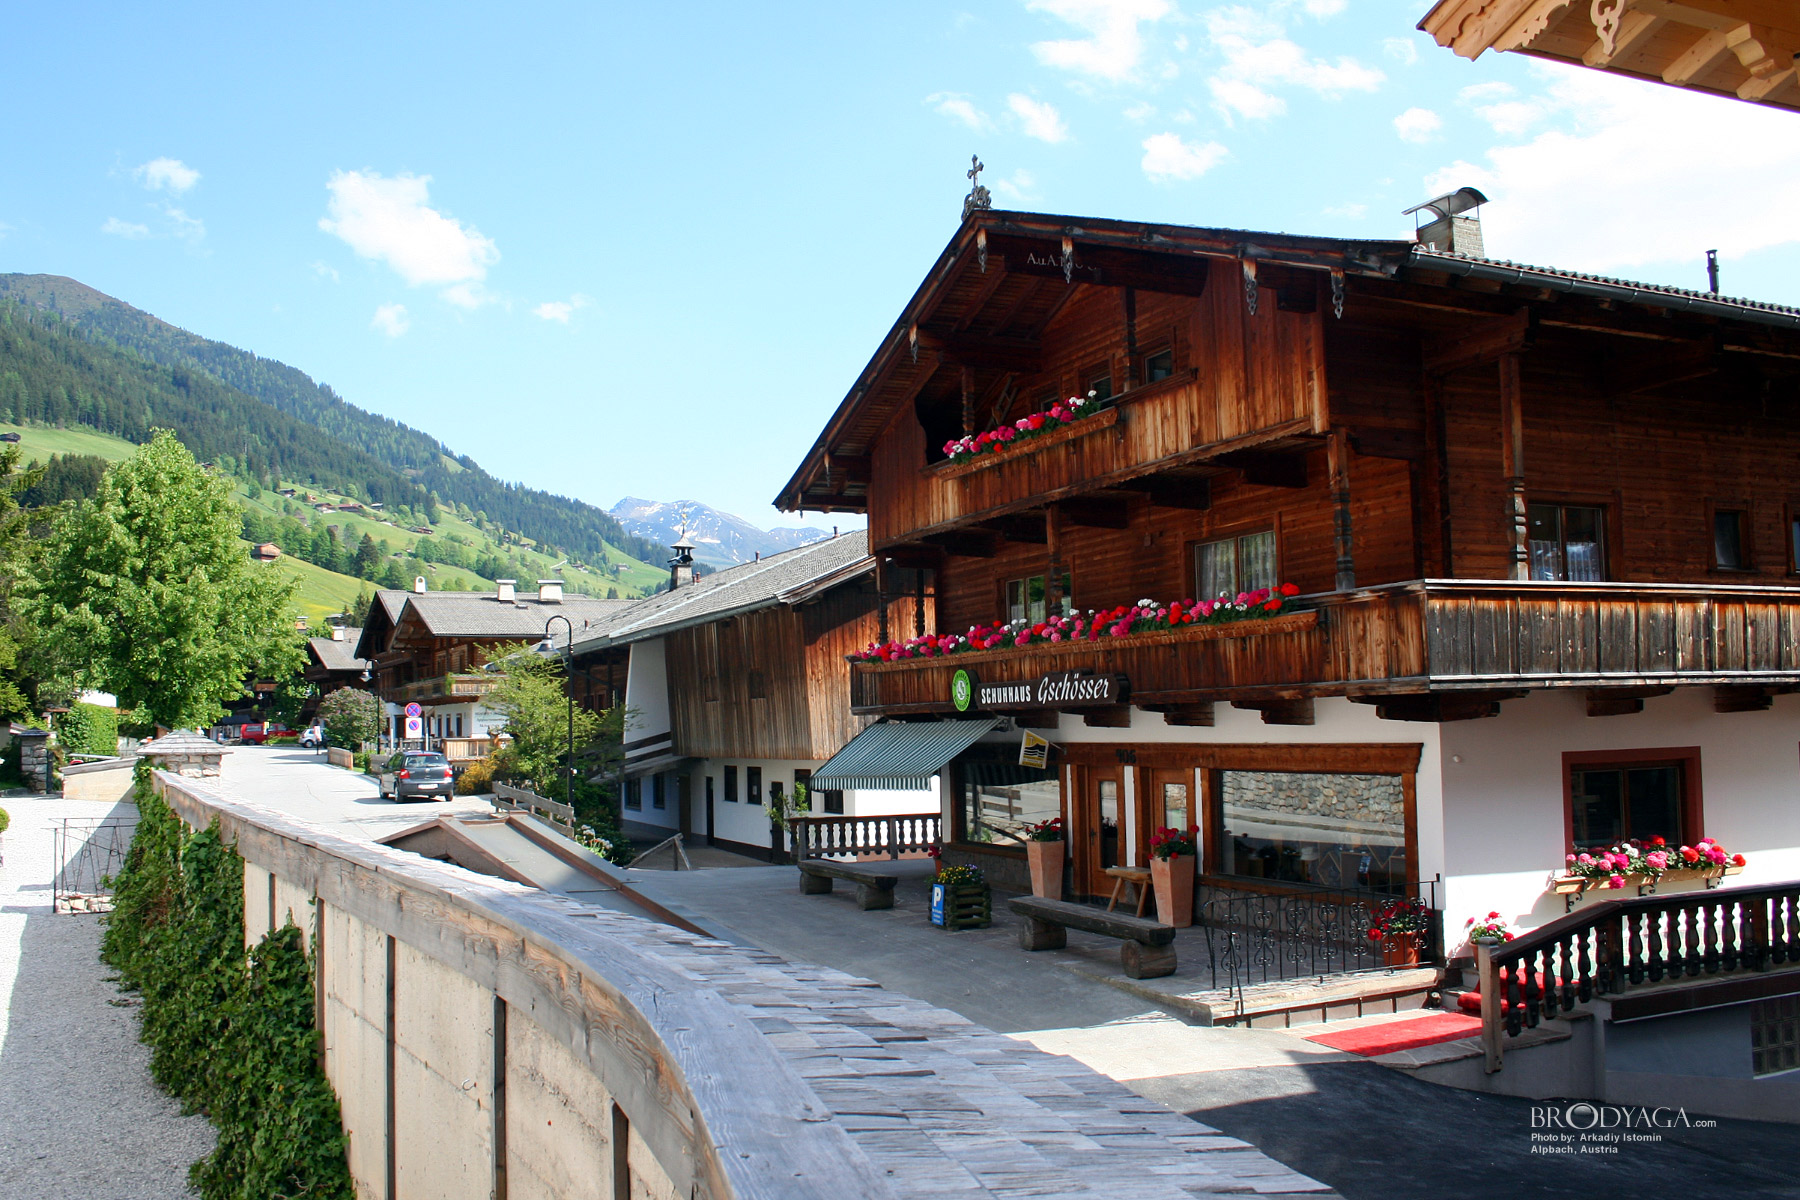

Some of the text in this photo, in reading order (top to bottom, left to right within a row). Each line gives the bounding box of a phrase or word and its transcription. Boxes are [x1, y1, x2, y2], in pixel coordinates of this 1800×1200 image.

[981, 685, 1031, 704] SCHUHHAUS
[1037, 673, 1109, 704] Gschösser
[933, 887, 941, 906] P
